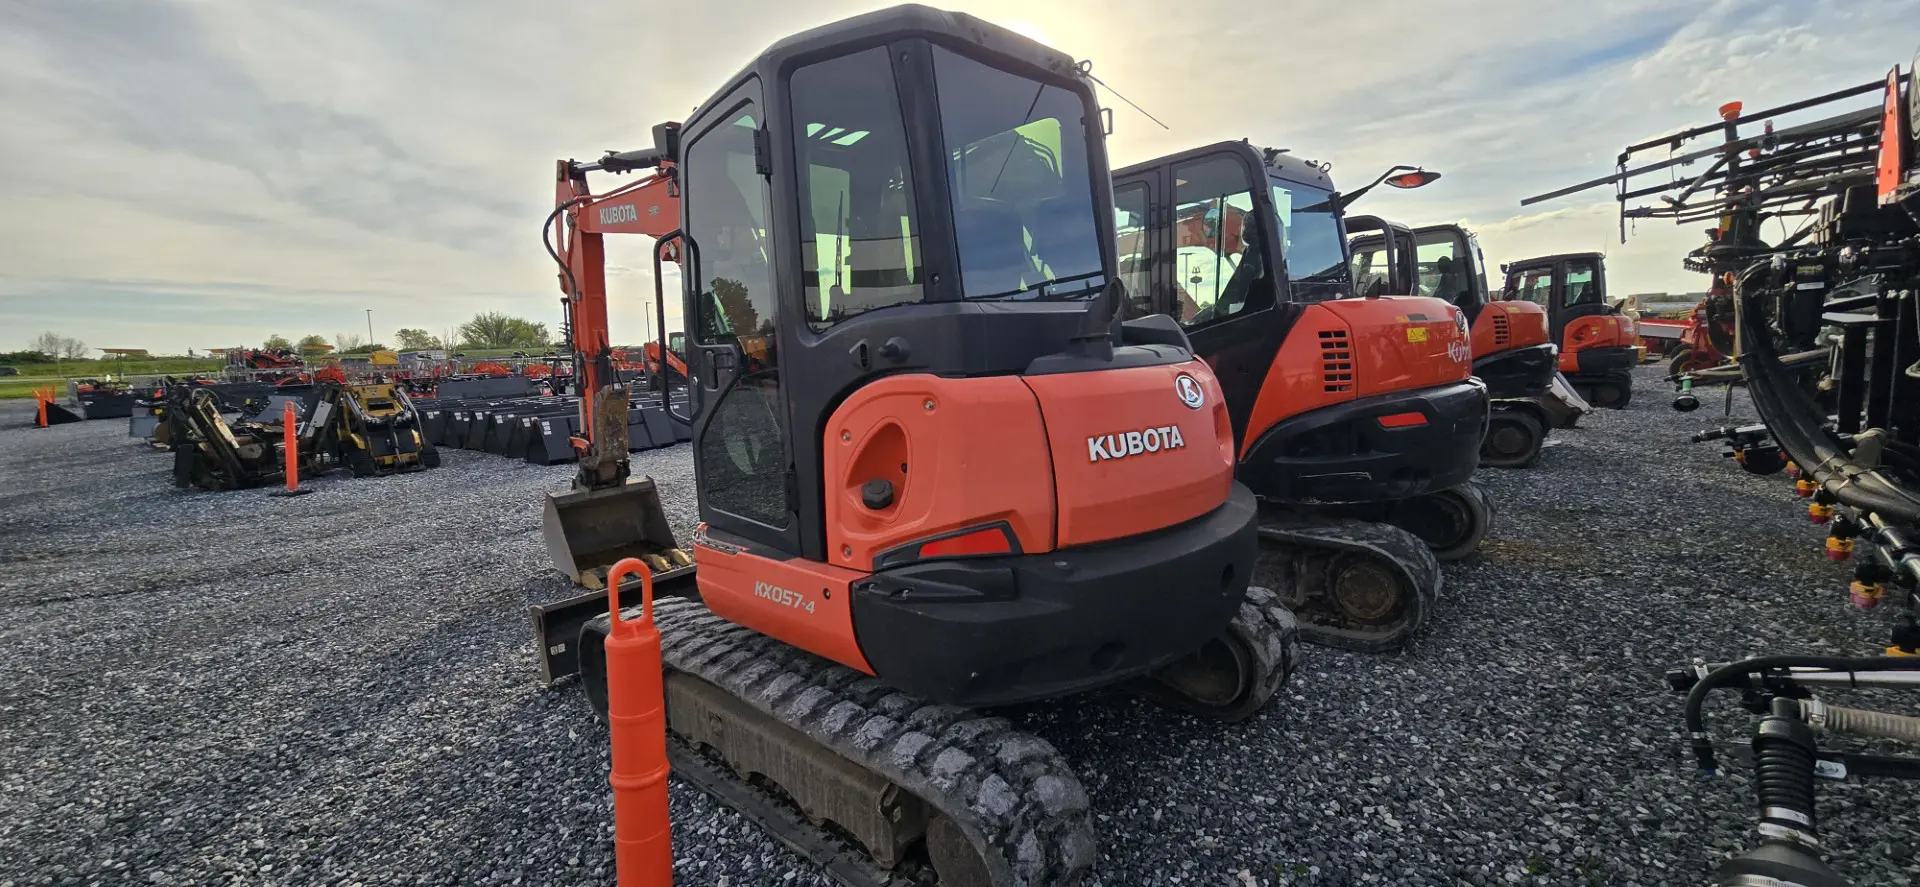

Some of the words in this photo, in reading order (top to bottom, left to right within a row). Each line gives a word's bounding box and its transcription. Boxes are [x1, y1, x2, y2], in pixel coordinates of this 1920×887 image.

[600, 204, 637, 225] KUBOTA
[1087, 425, 1185, 462] KUBOTA
[754, 580, 816, 614] KX057-4
